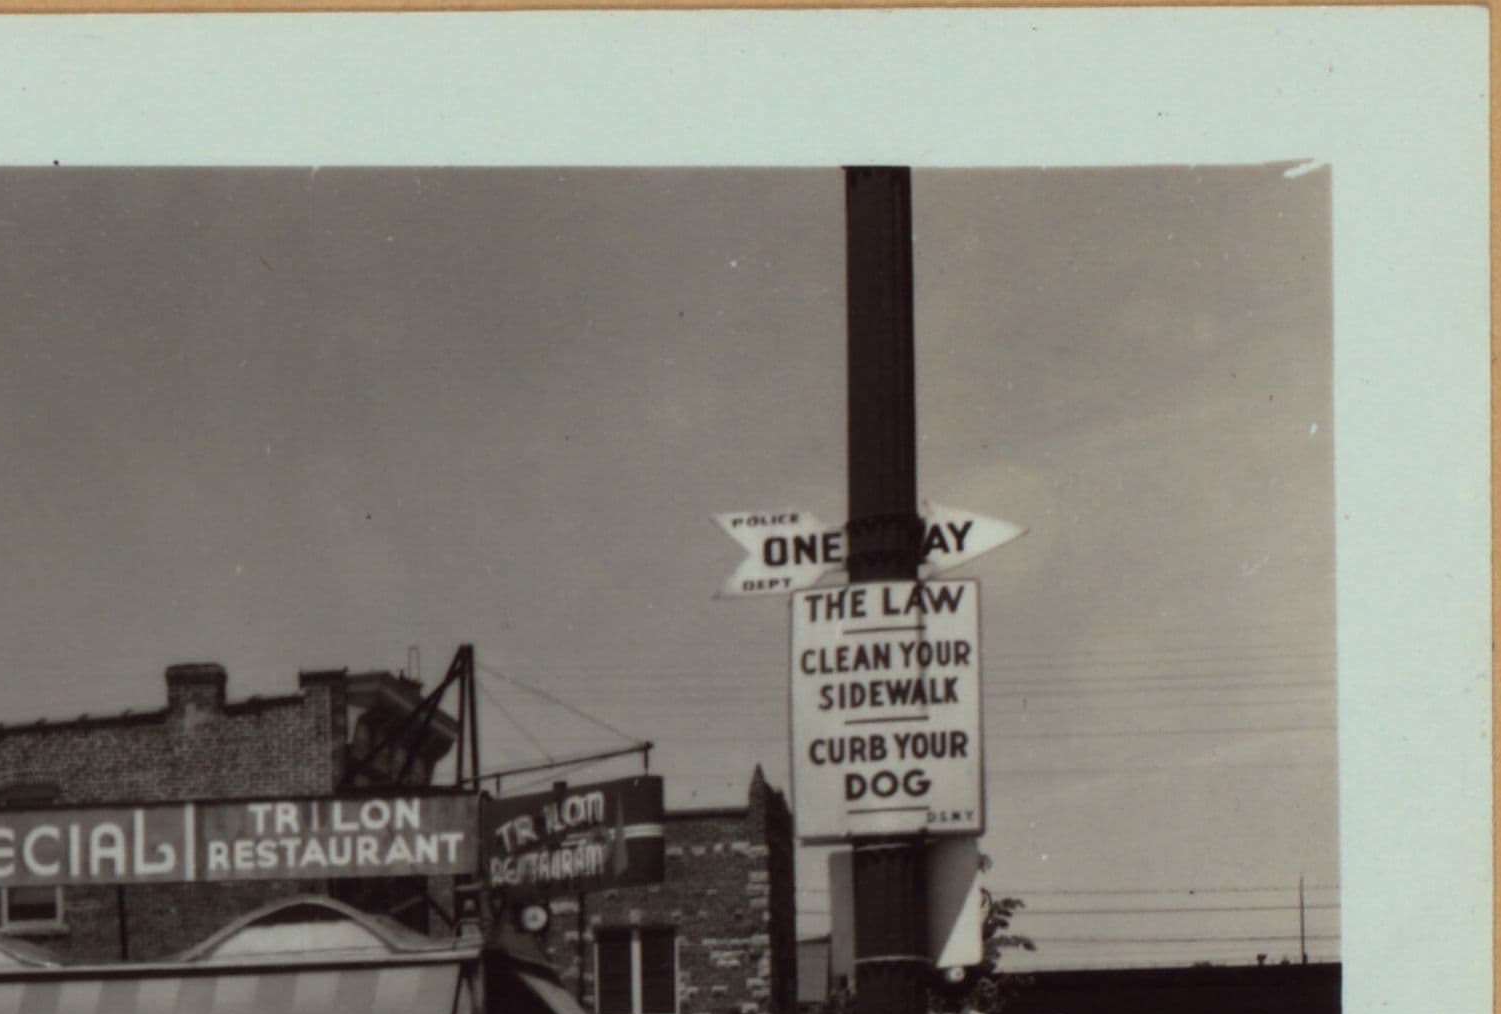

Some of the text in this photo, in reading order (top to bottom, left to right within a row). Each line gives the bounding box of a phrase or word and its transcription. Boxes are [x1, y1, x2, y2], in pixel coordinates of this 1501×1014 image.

[731, 513, 799, 528] POLICE
[762, 521, 972, 567] ONE AY
[742, 578, 792, 591] DEPT
[804, 585, 965, 622] THE LAW
[801, 640, 972, 675] CLEAN YOUR
[818, 677, 958, 711] SIDEWALK
[809, 731, 969, 765] CURB YOUR
[845, 769, 932, 801] DOG
[247, 798, 422, 834] TRILON
[208, 832, 465, 871] RESTAURANT
